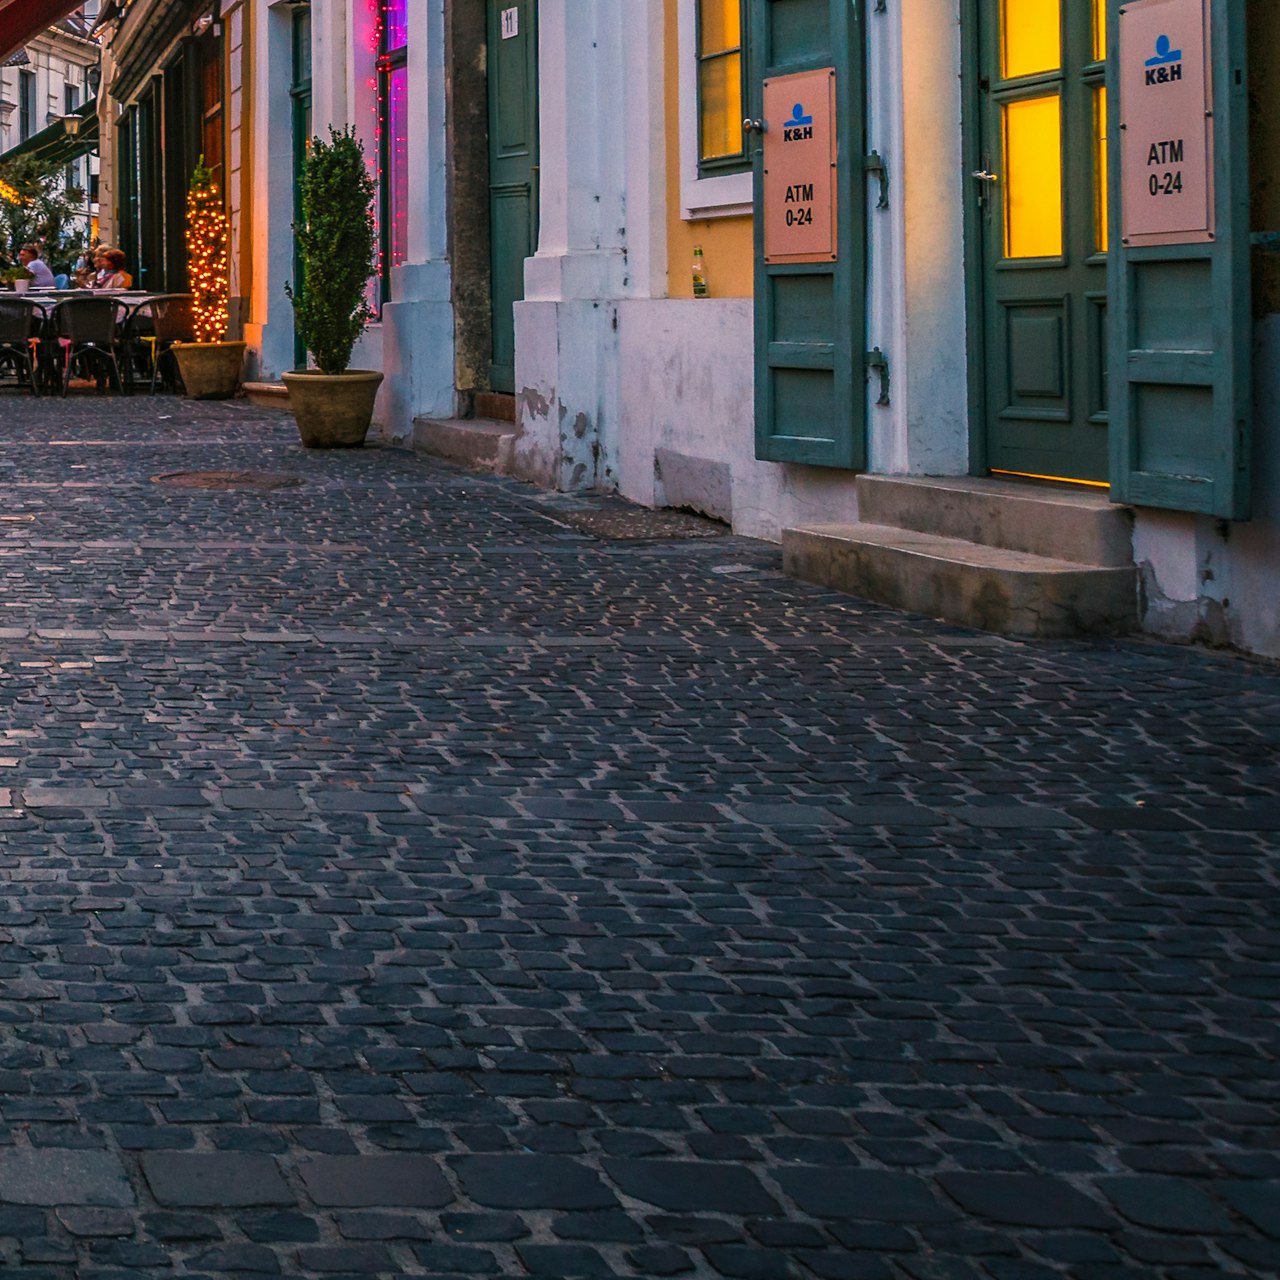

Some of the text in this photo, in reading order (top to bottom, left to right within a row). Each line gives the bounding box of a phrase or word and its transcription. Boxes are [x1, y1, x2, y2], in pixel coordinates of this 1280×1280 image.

[505, 12, 513, 33] 11
[1146, 63, 1182, 86] K&H
[783, 127, 813, 142] K&H
[1147, 139, 1184, 166] ATM
[784, 184, 814, 203] ATM
[1148, 171, 1183, 196] 0-24
[785, 207, 813, 227] 0-24
